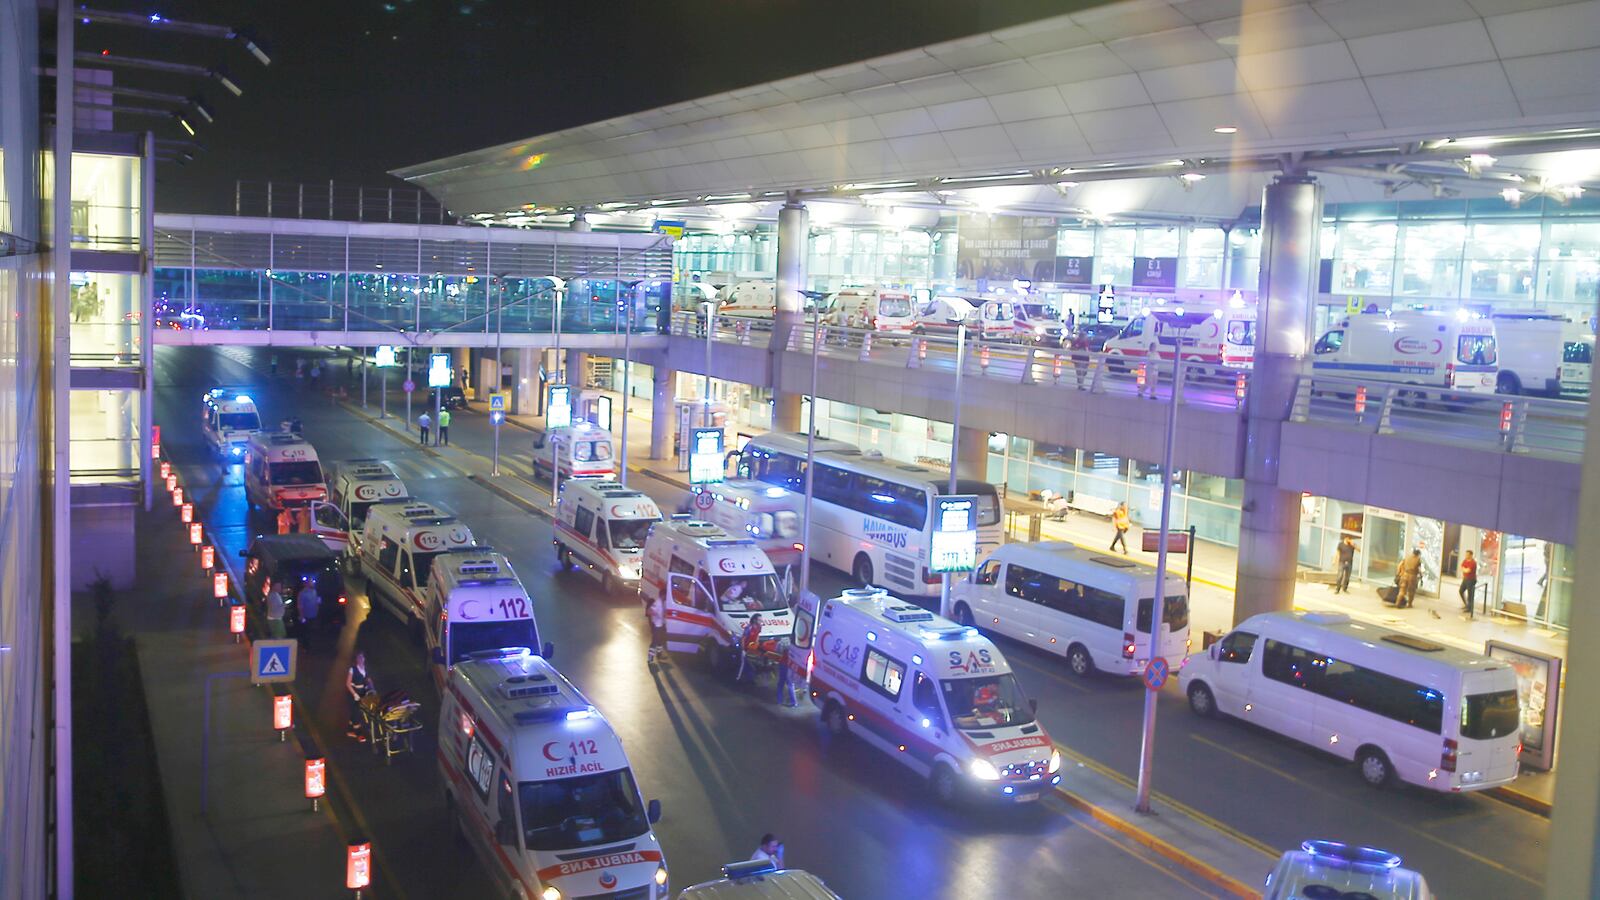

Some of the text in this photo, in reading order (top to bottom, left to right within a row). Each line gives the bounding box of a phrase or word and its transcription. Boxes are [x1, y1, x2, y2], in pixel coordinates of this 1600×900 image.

[700, 496, 711, 505] 30
[635, 504, 657, 517] 112
[422, 536, 438, 544] 112
[499, 598, 529, 619] 112
[569, 740, 598, 756] 112
[546, 760, 605, 777] HIZIR ACİL
